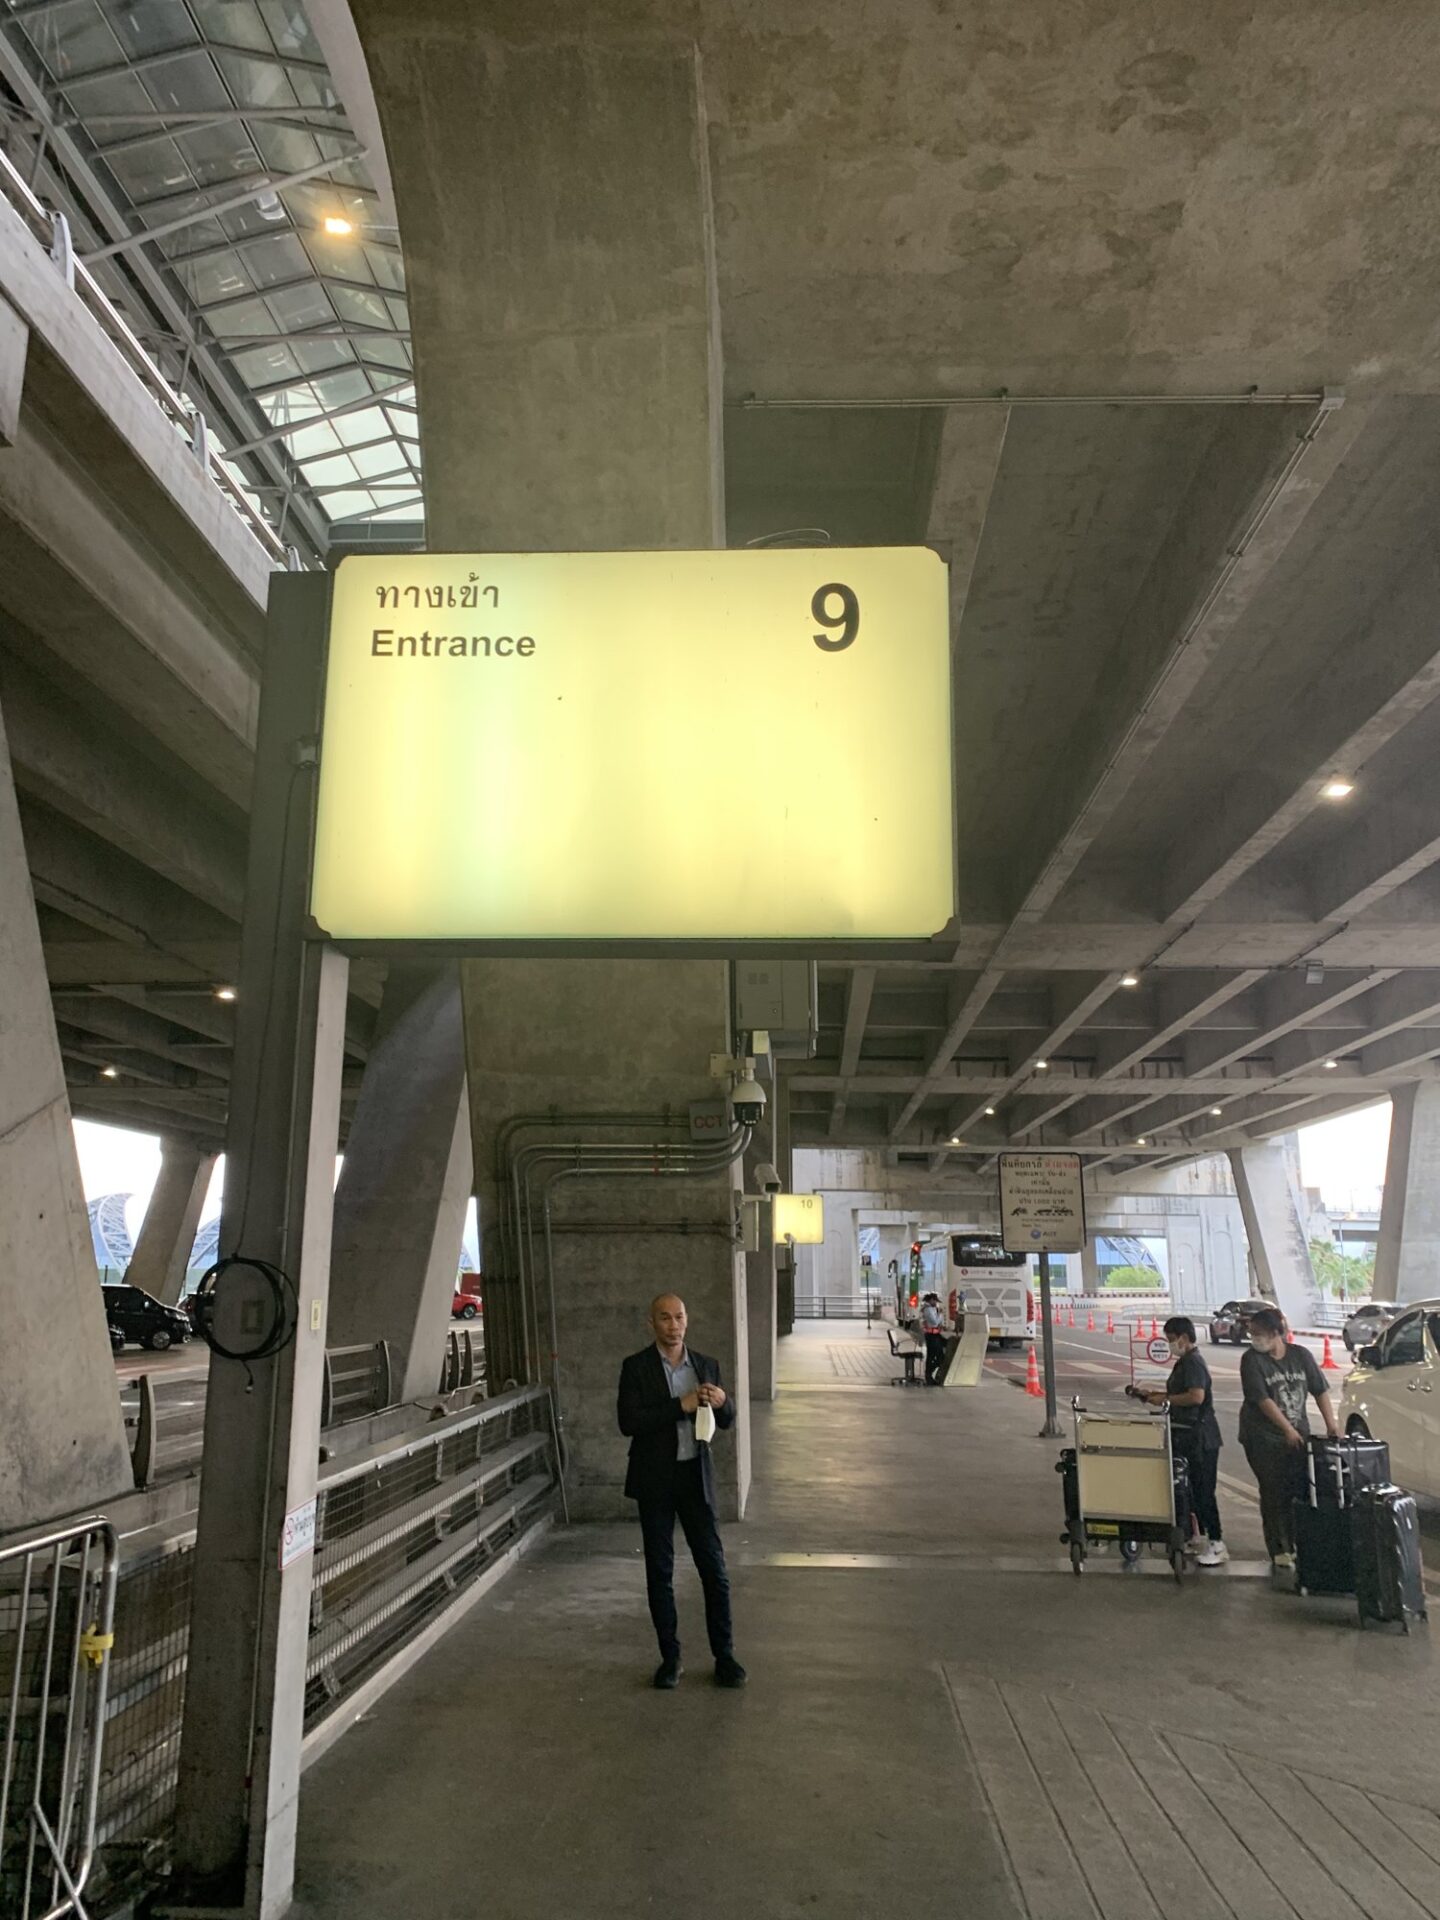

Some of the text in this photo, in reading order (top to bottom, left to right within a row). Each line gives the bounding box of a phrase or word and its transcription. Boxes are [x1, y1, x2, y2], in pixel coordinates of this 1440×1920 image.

[375, 571, 500, 609] ทางเข้า
[810, 582, 861, 653] 9
[370, 629, 537, 658] Entrance
[801, 1199, 813, 1209] 10
